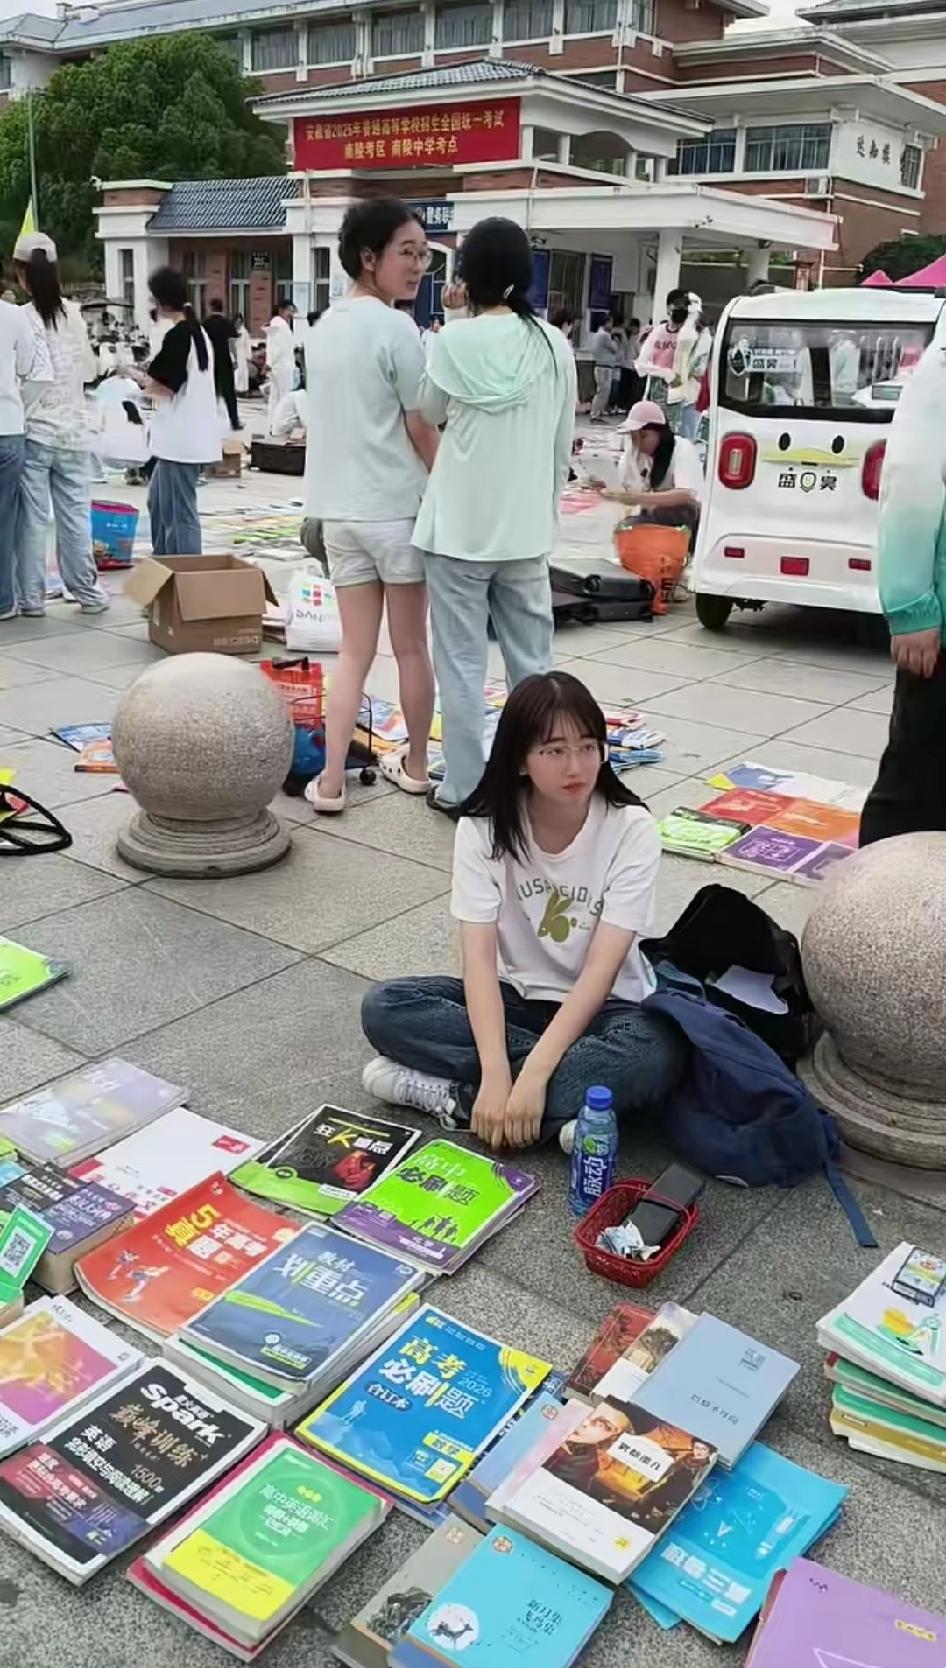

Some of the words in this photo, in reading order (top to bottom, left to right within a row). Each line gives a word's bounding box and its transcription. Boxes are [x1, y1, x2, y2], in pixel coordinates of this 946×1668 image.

[391, 136, 458, 158] 南陵中学考点
[582, 1156, 607, 1197] 脉动
[273, 1252, 370, 1308] 划重点
[399, 1335, 467, 1380] 高考
[367, 1382, 412, 1411] 合订本
[378, 1357, 480, 1420] 必刷题
[140, 1383, 226, 1446] Spark
[80, 1424, 118, 1453] 英语
